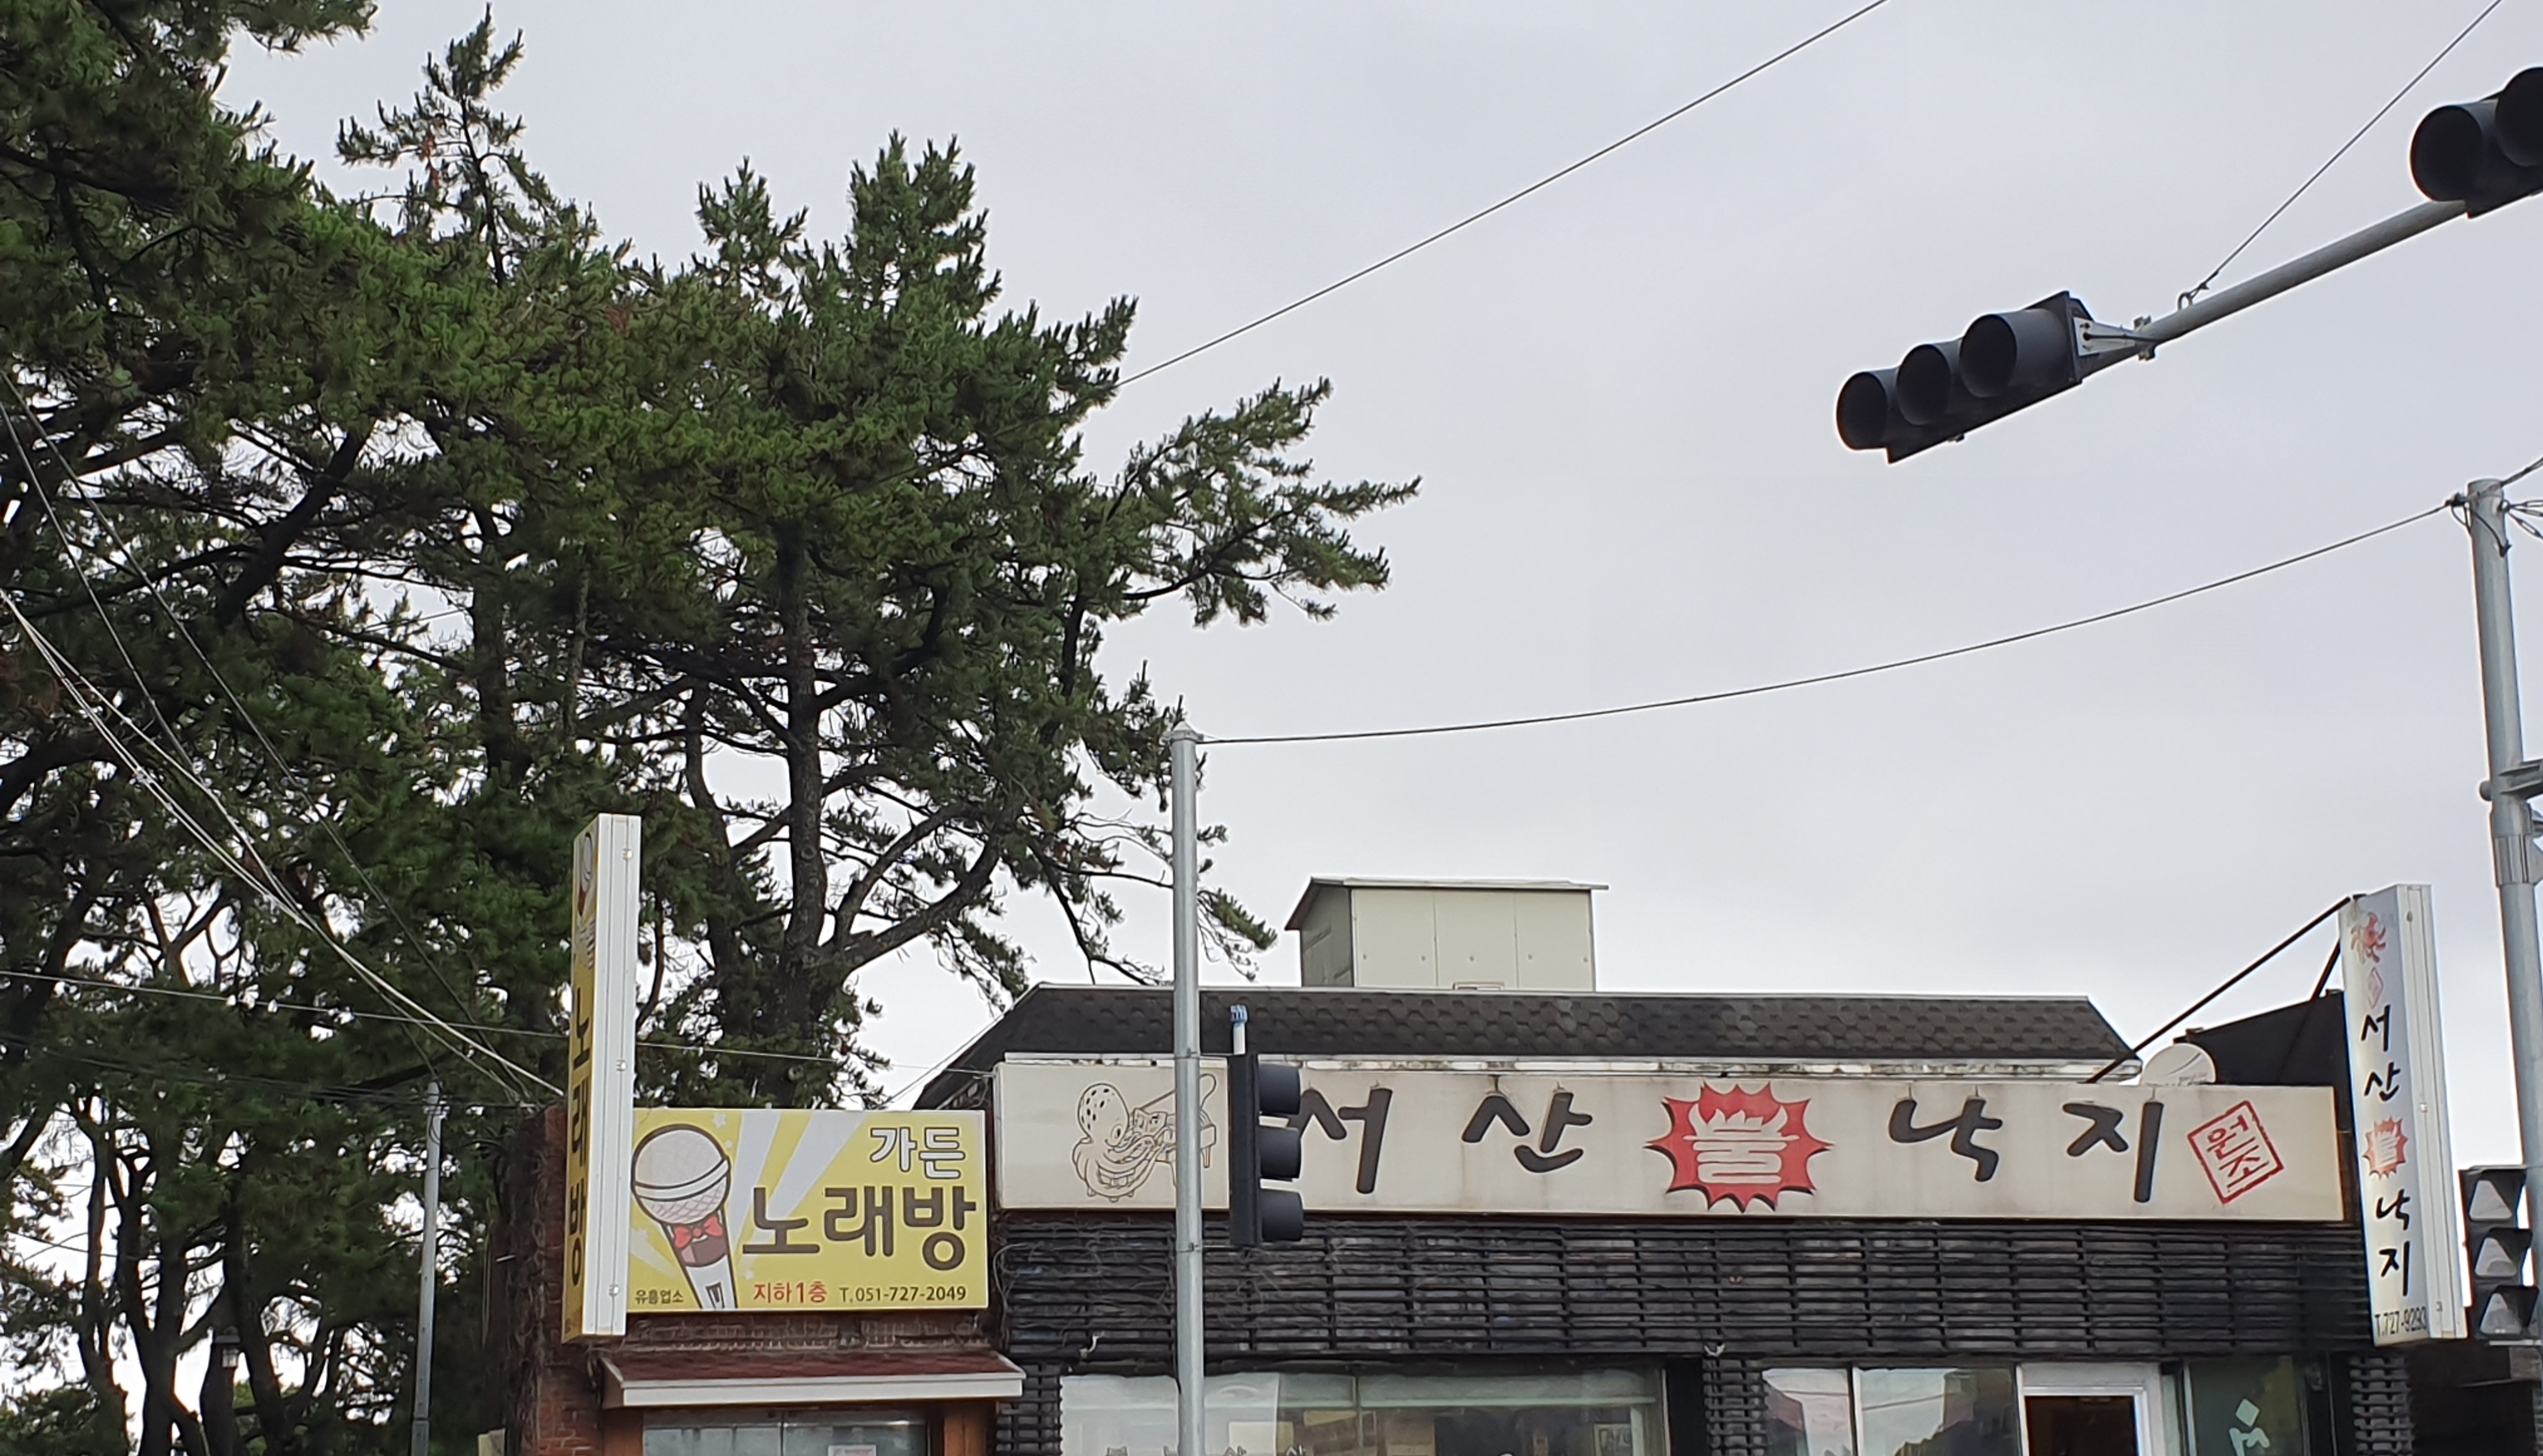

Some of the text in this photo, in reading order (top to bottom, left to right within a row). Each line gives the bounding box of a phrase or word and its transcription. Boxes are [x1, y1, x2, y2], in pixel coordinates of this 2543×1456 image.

[869, 1126, 966, 1179] 가든
[742, 1185, 977, 1271] 노래방
[753, 1281, 827, 1303] 지하1층
